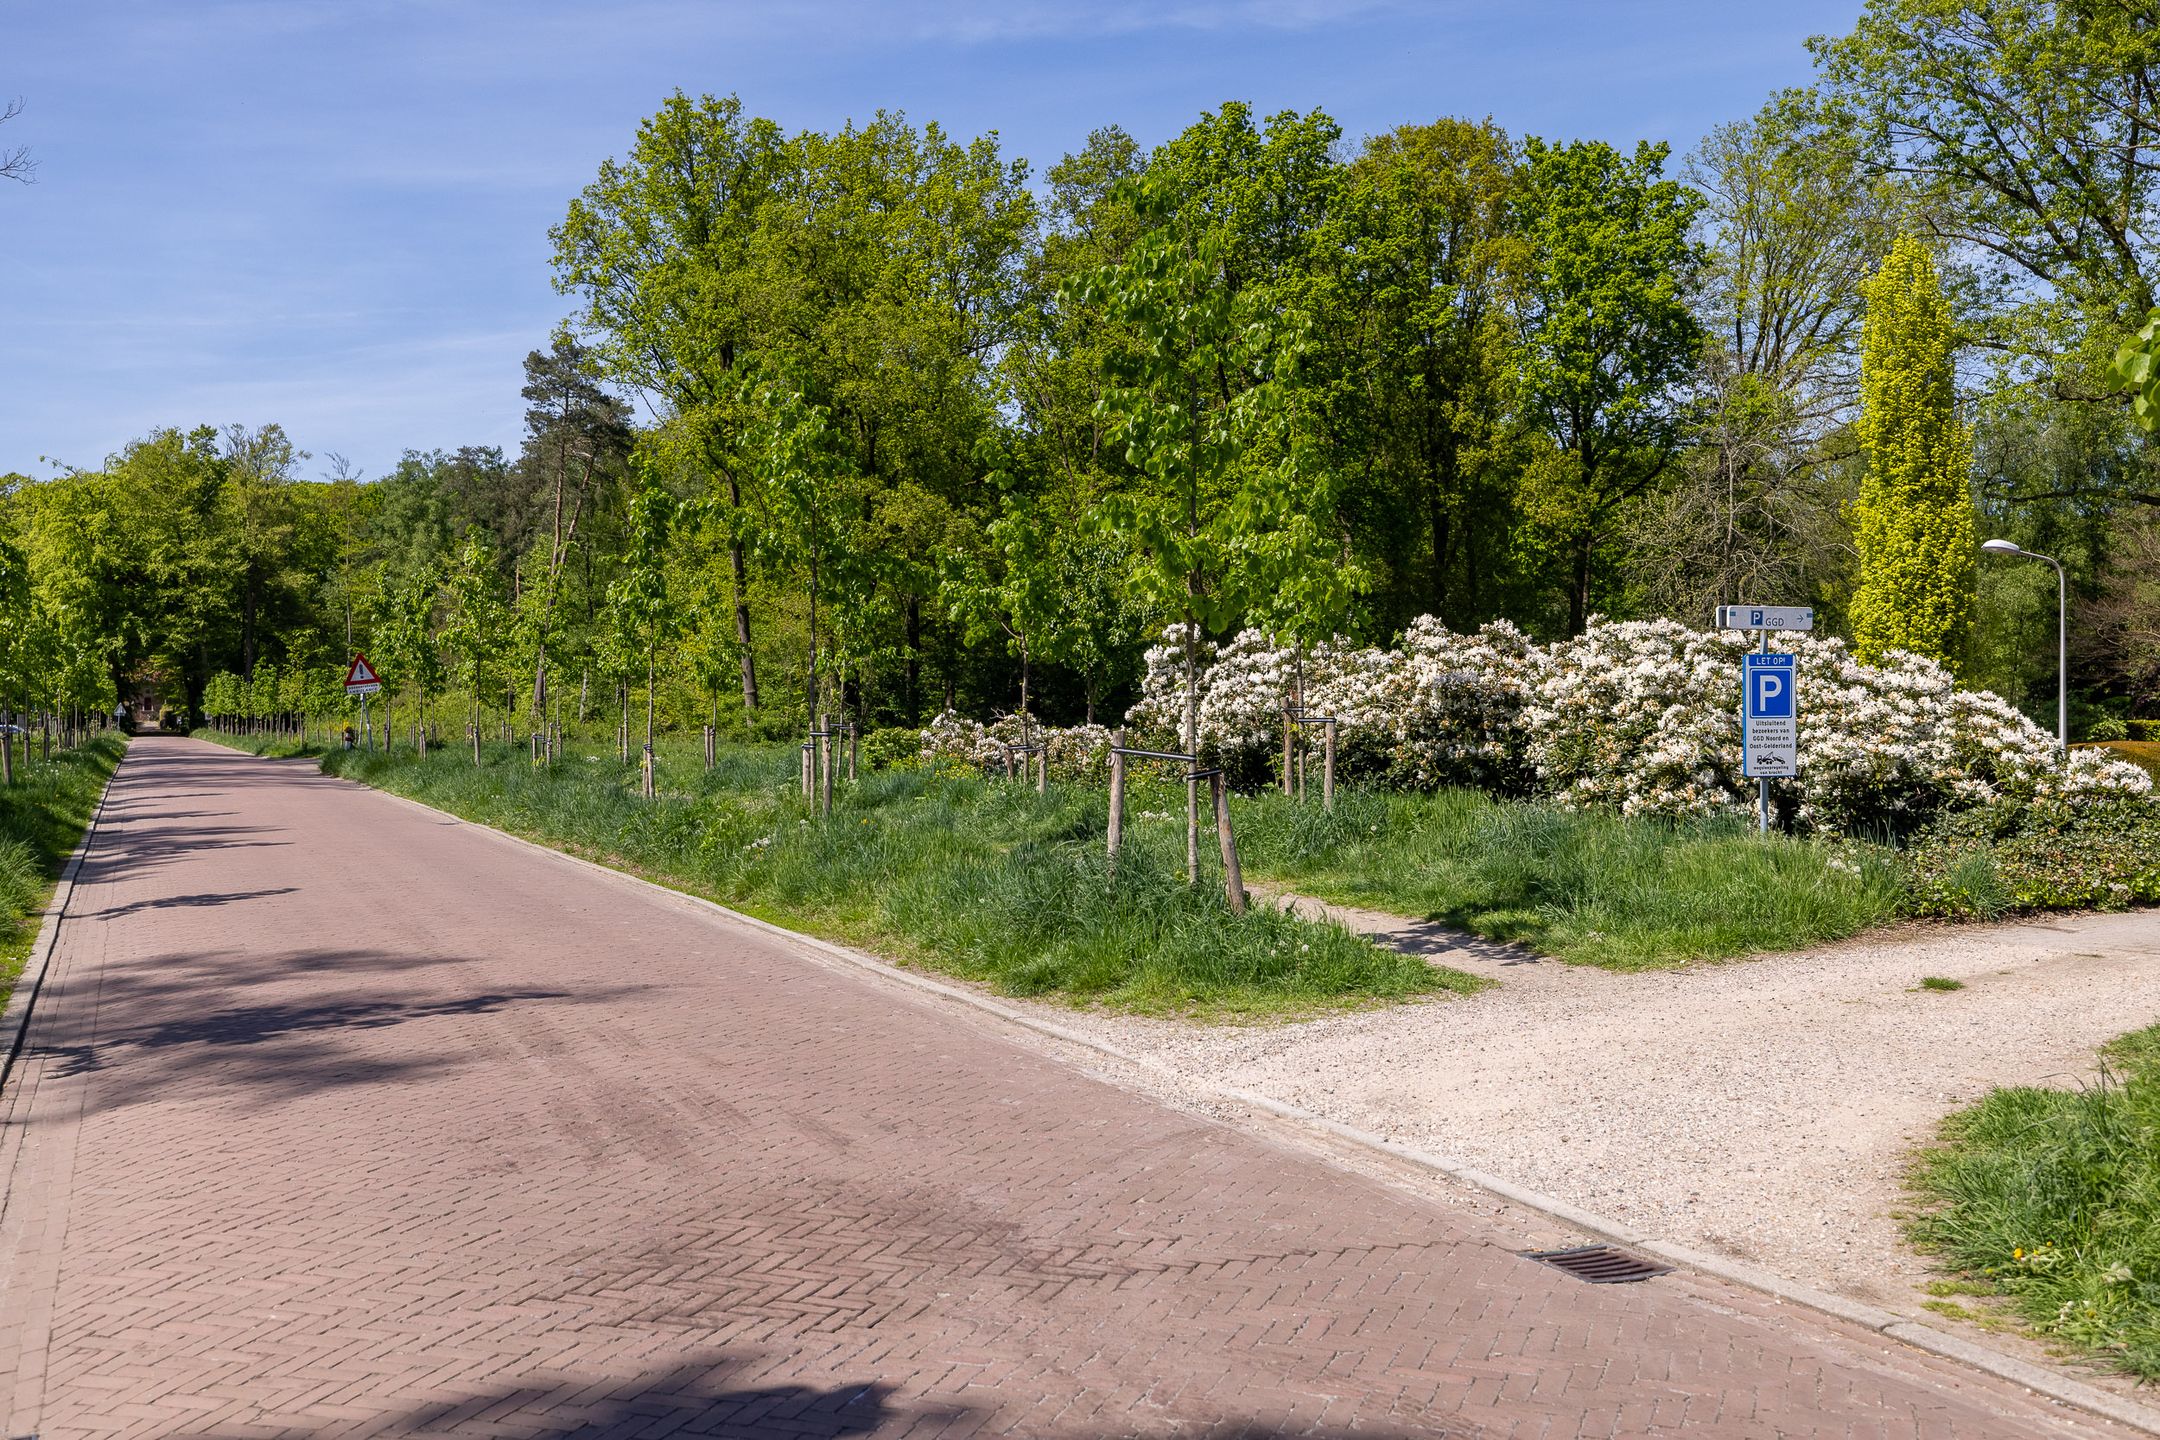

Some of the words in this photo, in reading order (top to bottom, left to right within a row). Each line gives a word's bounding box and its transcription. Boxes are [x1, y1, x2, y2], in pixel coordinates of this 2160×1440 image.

[1754, 612, 1760, 624] P
[1766, 618, 1784, 626] GGD
[1756, 657, 1770, 665] LET
[1773, 657, 1786, 665] OP!
[1760, 675, 1782, 711] P
